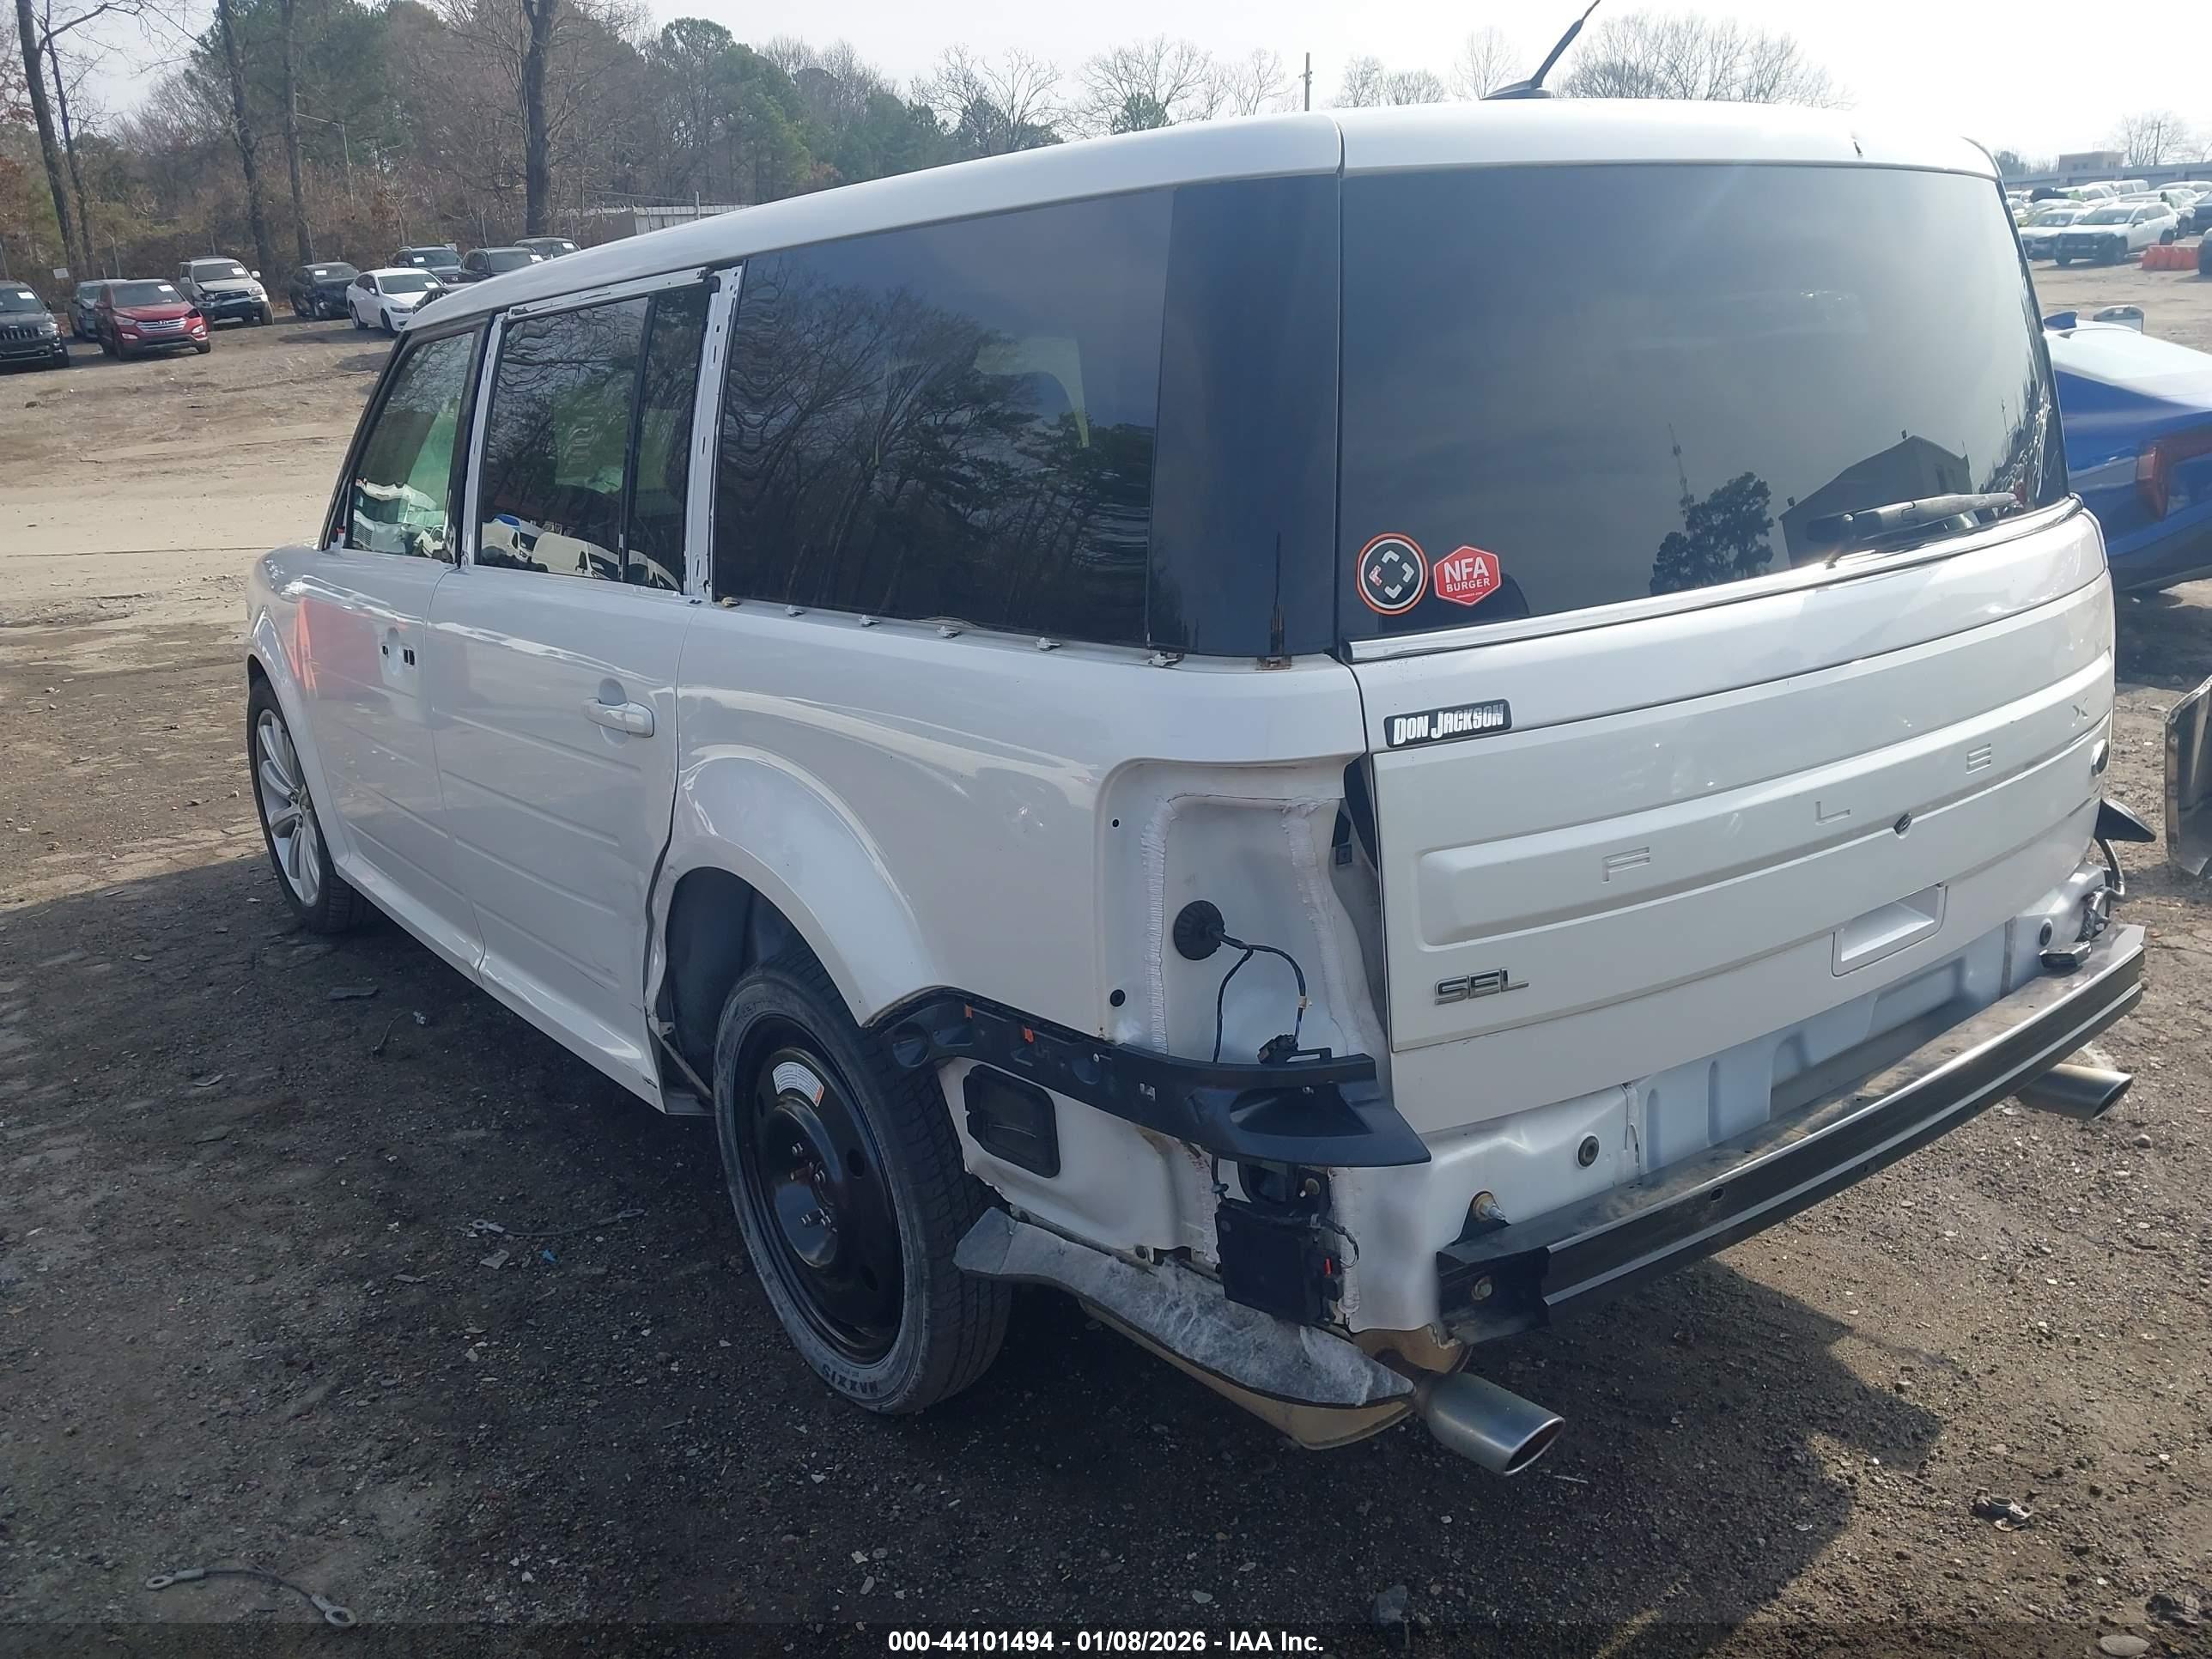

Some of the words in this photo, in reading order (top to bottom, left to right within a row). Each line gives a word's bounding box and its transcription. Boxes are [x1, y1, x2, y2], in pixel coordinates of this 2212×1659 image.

[1443, 556, 1490, 583] NFA
[1446, 578, 1491, 592] BURGER
[1393, 715, 1430, 745] DON
[1431, 704, 1504, 738] JACKSON
[1435, 968, 1529, 1005] SEL
